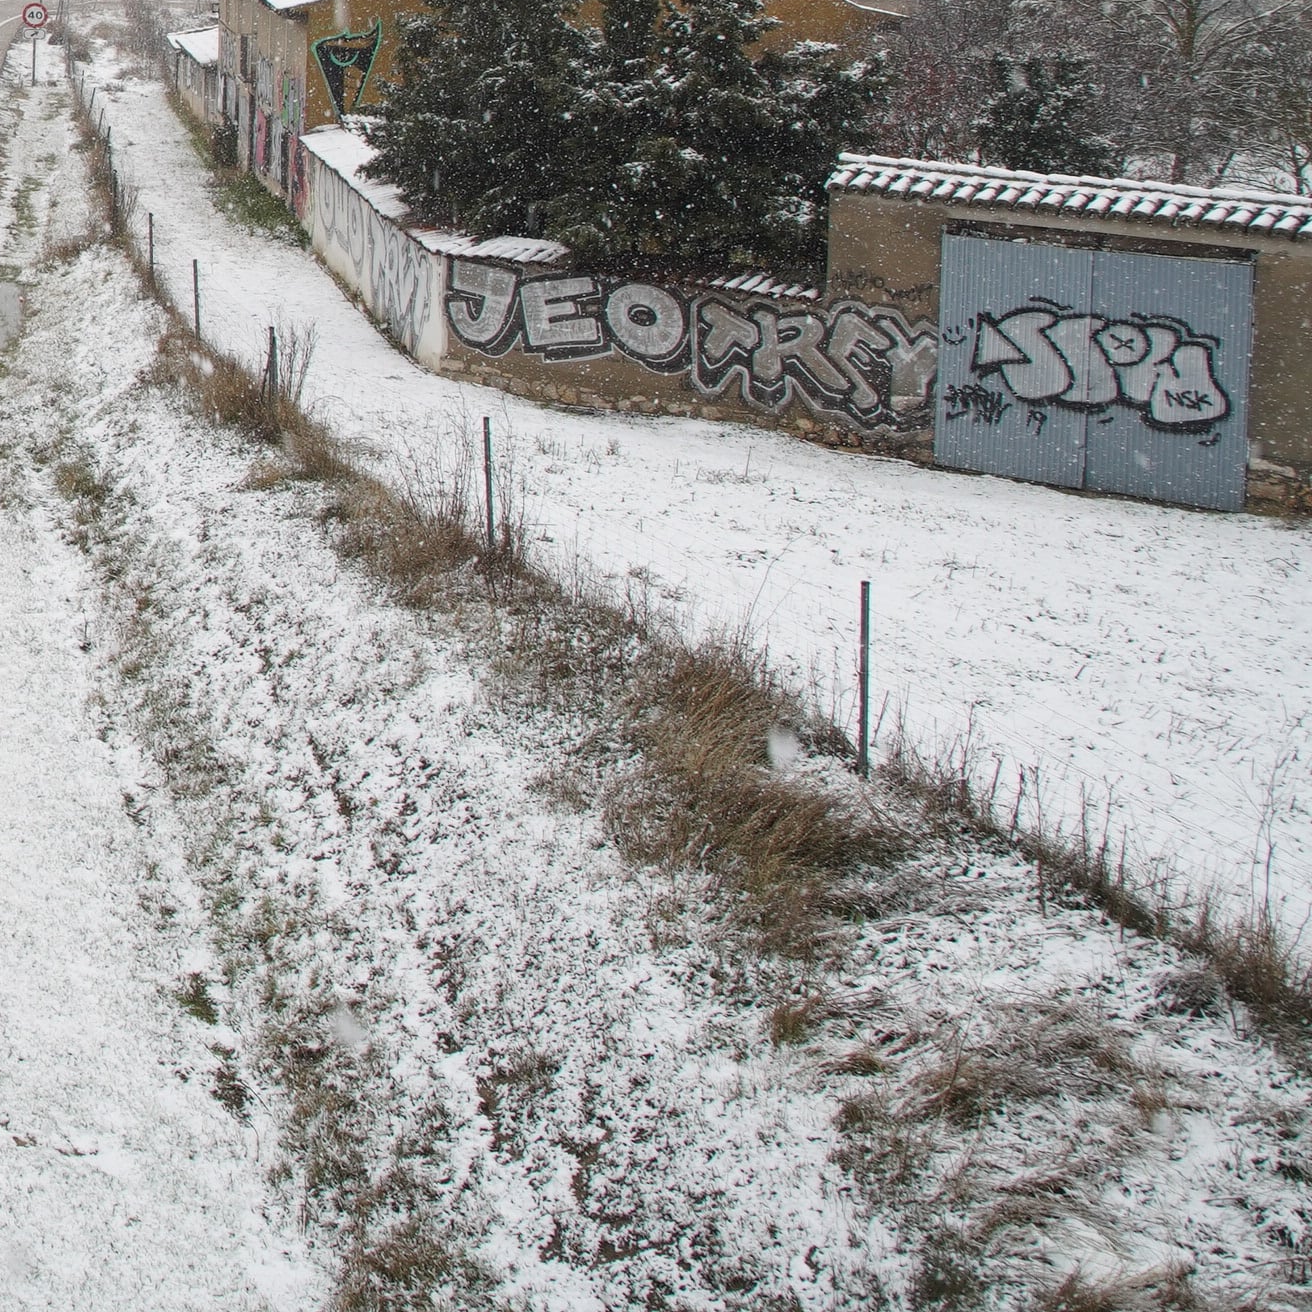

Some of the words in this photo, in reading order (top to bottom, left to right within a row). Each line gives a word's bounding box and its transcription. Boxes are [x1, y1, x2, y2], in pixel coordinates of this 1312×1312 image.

[27, 11, 43, 20] 40
[446, 256, 692, 372] JEO
[1163, 389, 1213, 412] NSK
